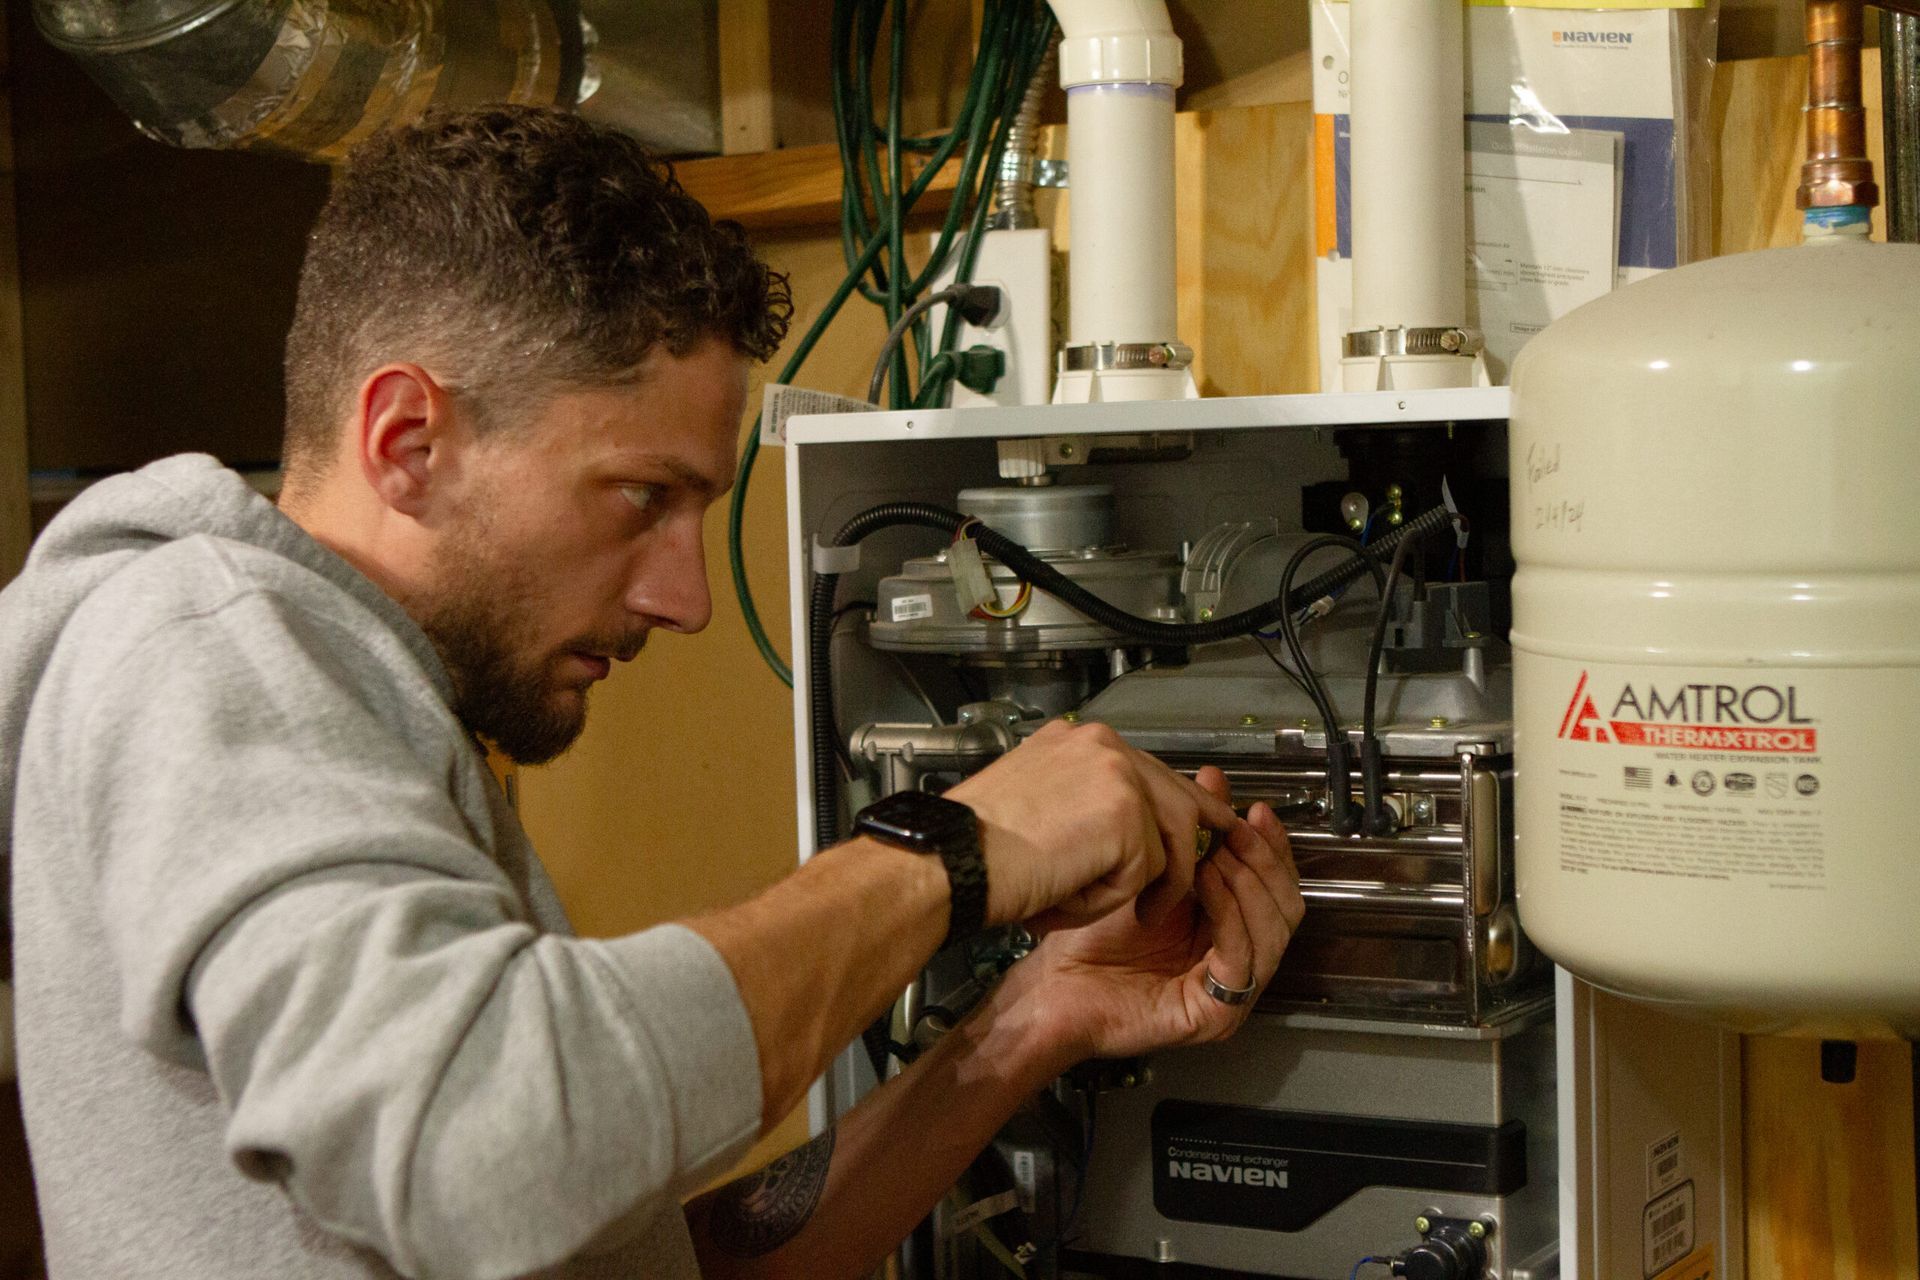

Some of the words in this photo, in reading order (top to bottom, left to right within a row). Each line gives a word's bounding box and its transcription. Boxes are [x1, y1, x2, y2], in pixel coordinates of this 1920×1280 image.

[1611, 682, 1813, 724] AMTROL
[1729, 755, 1788, 765] EXPANSION
[1793, 756, 1822, 766] TANK
[1168, 1146, 1220, 1162] Condensing
[1222, 1152, 1241, 1163] heat
[1243, 1155, 1288, 1168] exchanger
